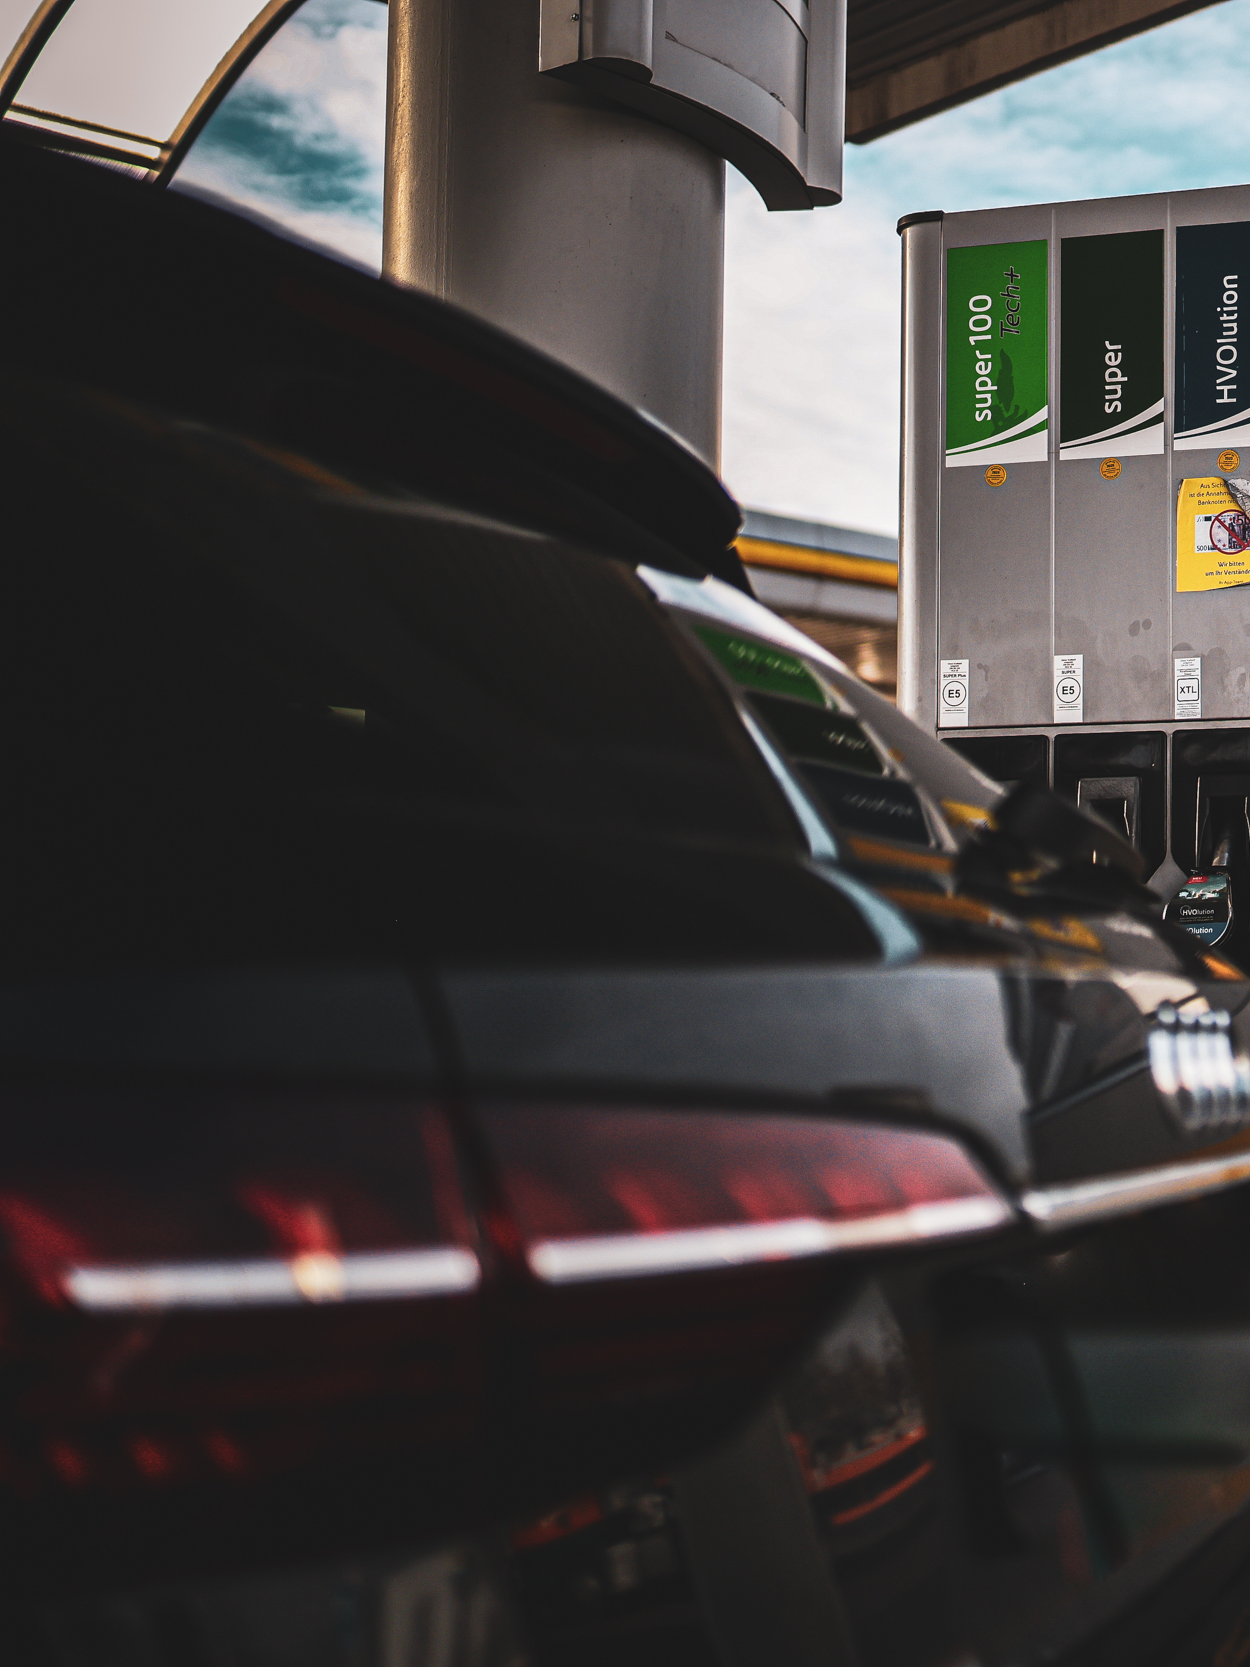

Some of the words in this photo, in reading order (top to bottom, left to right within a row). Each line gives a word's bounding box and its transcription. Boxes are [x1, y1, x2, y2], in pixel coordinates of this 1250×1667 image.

[968, 294, 992, 345] 100
[1000, 266, 1021, 338] Tech+
[1216, 275, 1238, 403] HVOlution
[975, 350, 998, 422] super
[1104, 340, 1128, 414] super
[948, 689, 961, 699] E5
[1062, 686, 1075, 695] E5
[1180, 686, 1197, 694] XTL
[1182, 908, 1215, 916] HVOlution
